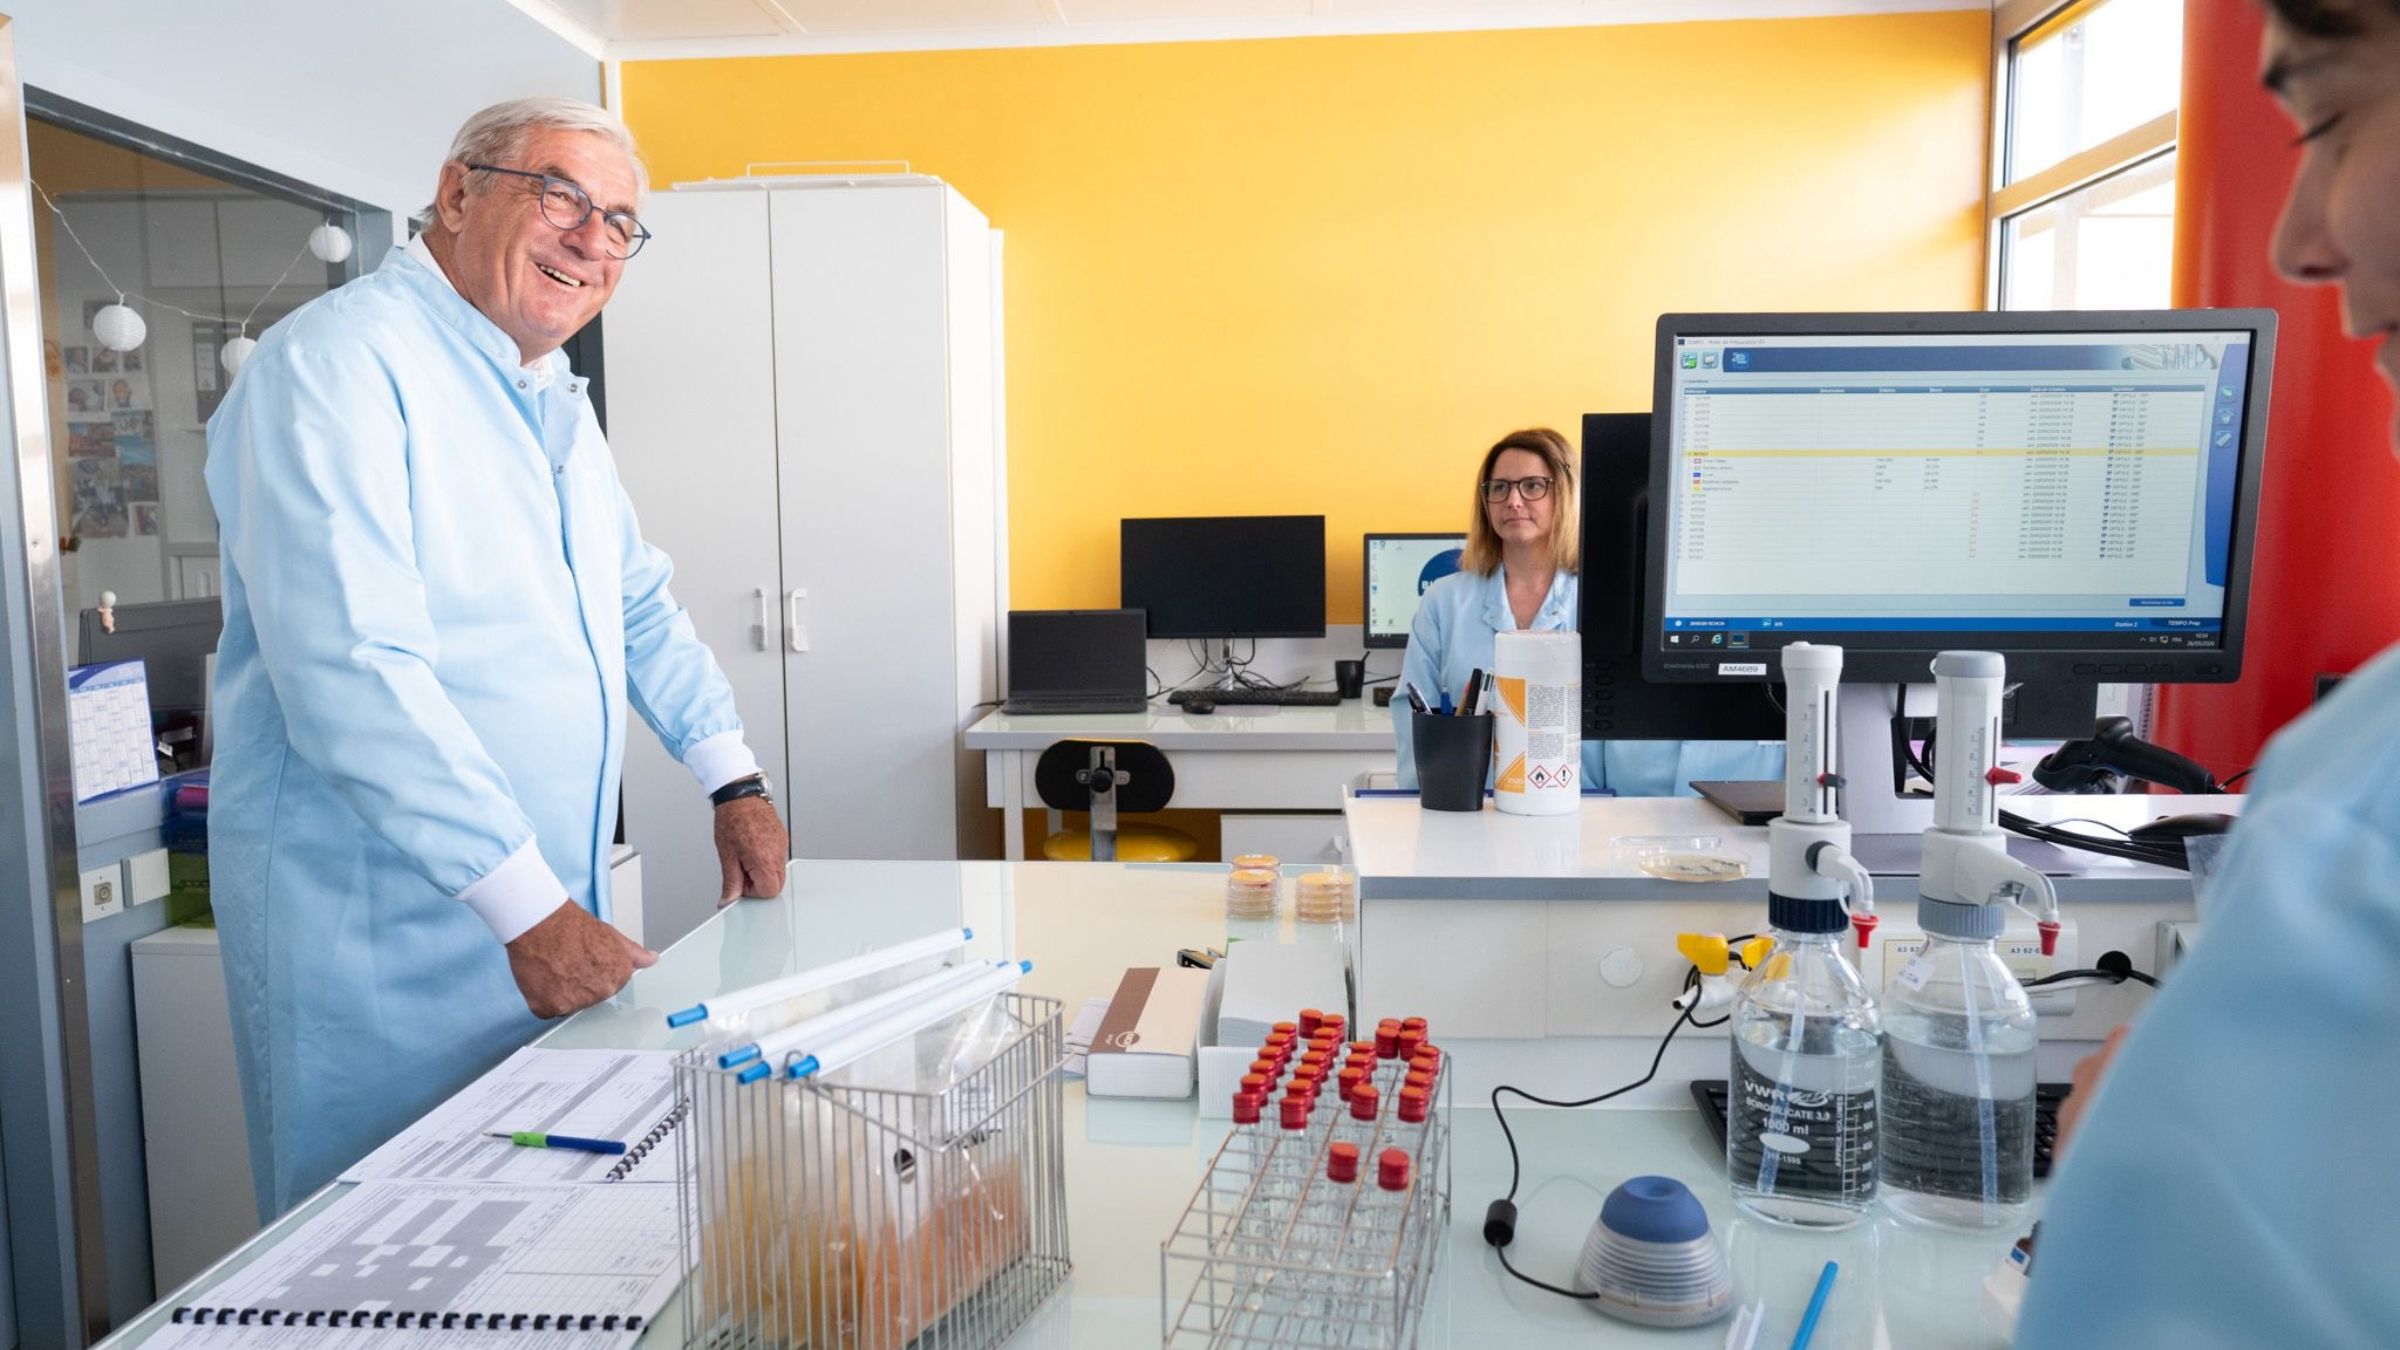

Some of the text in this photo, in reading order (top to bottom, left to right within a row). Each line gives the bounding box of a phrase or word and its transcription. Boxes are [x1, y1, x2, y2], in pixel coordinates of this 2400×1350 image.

[1744, 1079, 1785, 1100] VWR
[1762, 1117, 1809, 1135] 1000 ml
